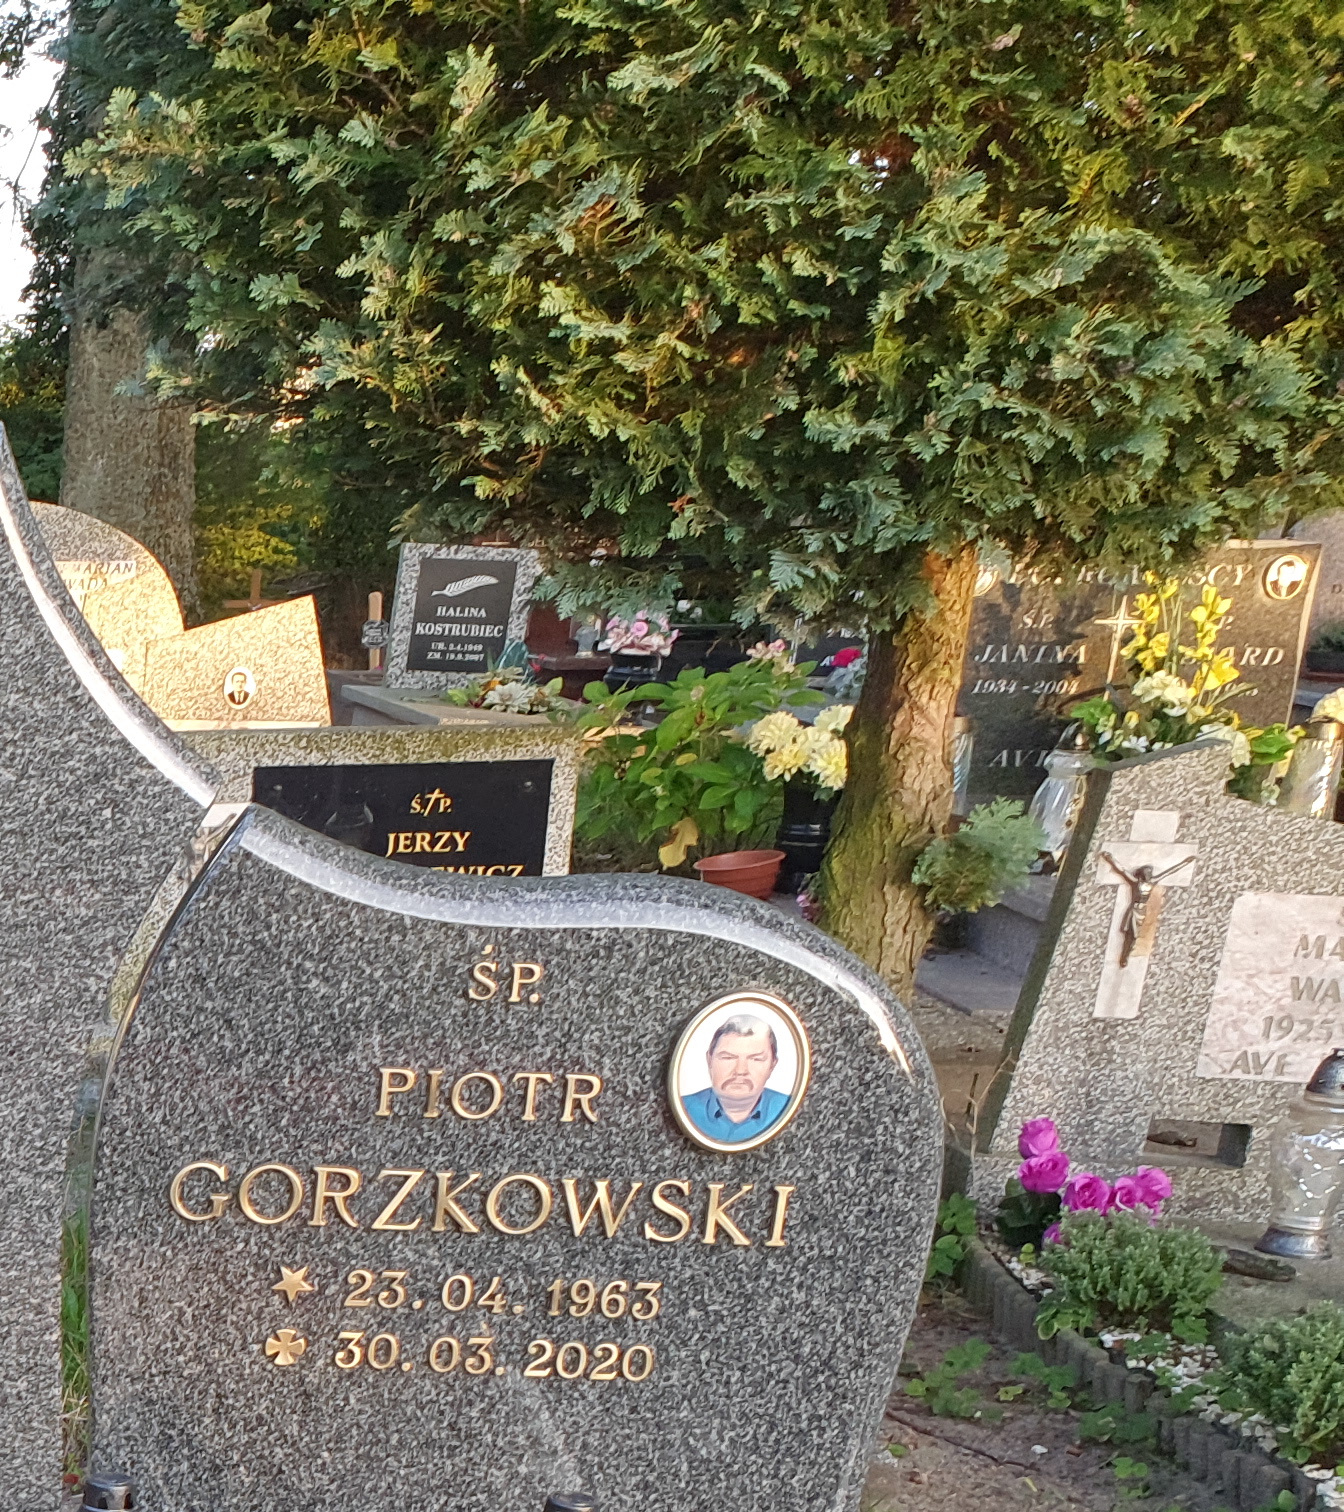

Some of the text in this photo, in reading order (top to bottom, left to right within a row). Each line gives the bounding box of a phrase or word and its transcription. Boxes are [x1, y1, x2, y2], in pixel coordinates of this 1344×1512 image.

[436, 605, 487, 618] HALINA
[415, 622, 504, 637] KOSTRUBIEC
[973, 644, 1087, 665] JANINA
[385, 830, 472, 859] JERZY
[374, 1066, 604, 1124] PIOTR
[169, 1160, 796, 1247] GORZKOWSKI
